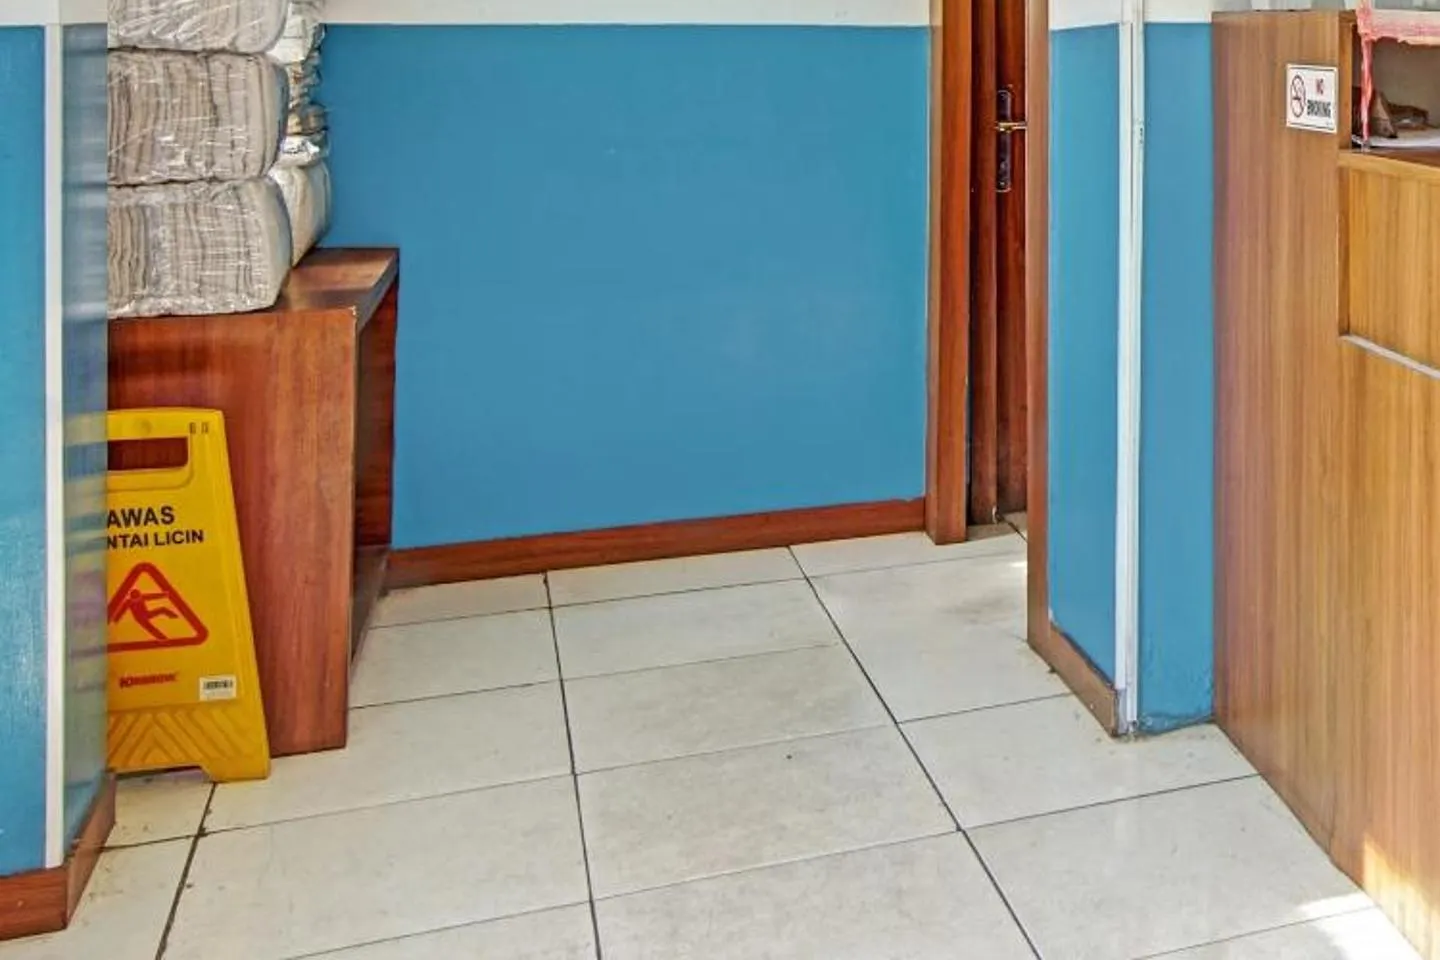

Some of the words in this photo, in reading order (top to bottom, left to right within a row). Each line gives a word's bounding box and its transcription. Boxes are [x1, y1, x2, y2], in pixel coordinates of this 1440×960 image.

[107, 505, 175, 528] AWAS
[107, 532, 149, 550] NTAI
[154, 529, 205, 547] LICIN
